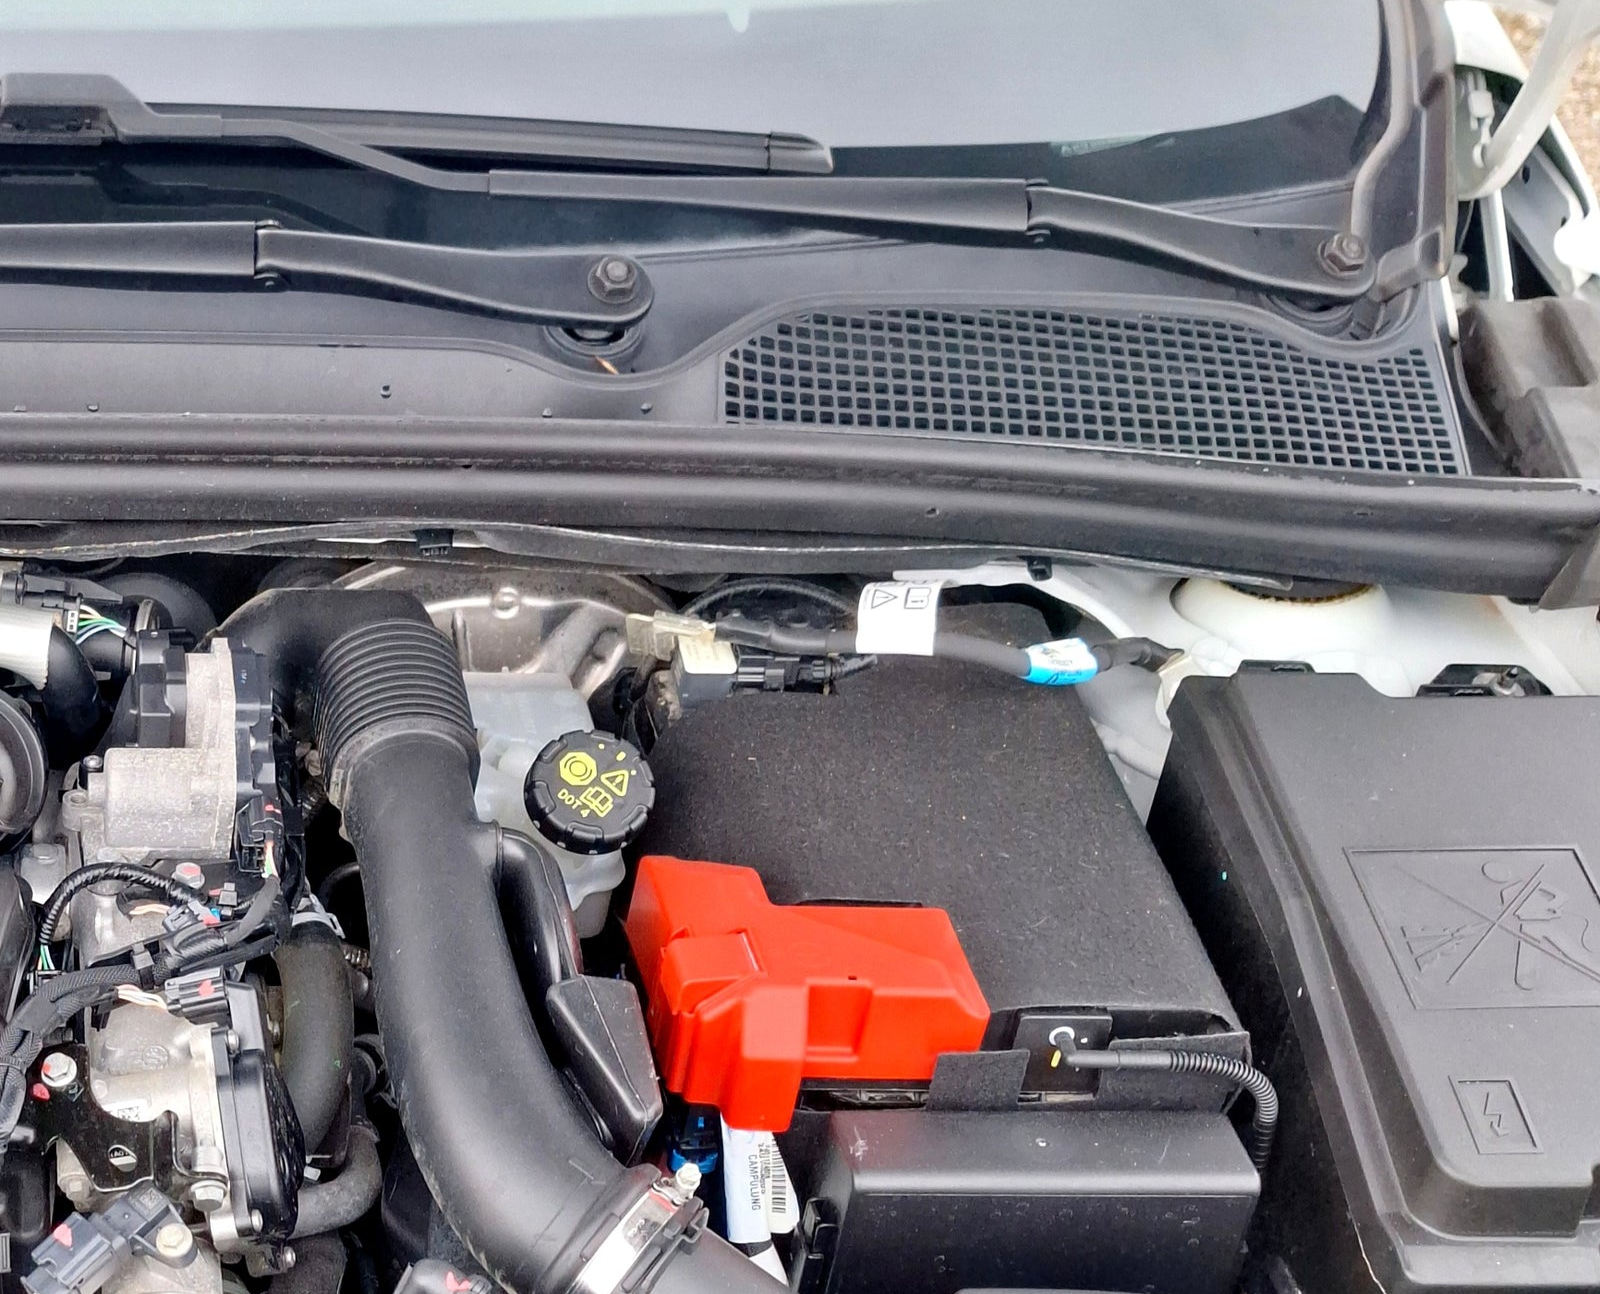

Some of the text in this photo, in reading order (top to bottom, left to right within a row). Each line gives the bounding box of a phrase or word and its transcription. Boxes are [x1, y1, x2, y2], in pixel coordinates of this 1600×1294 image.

[557, 788, 590, 818] DOT 4
[748, 1154, 761, 1210] CAMPULUNG
